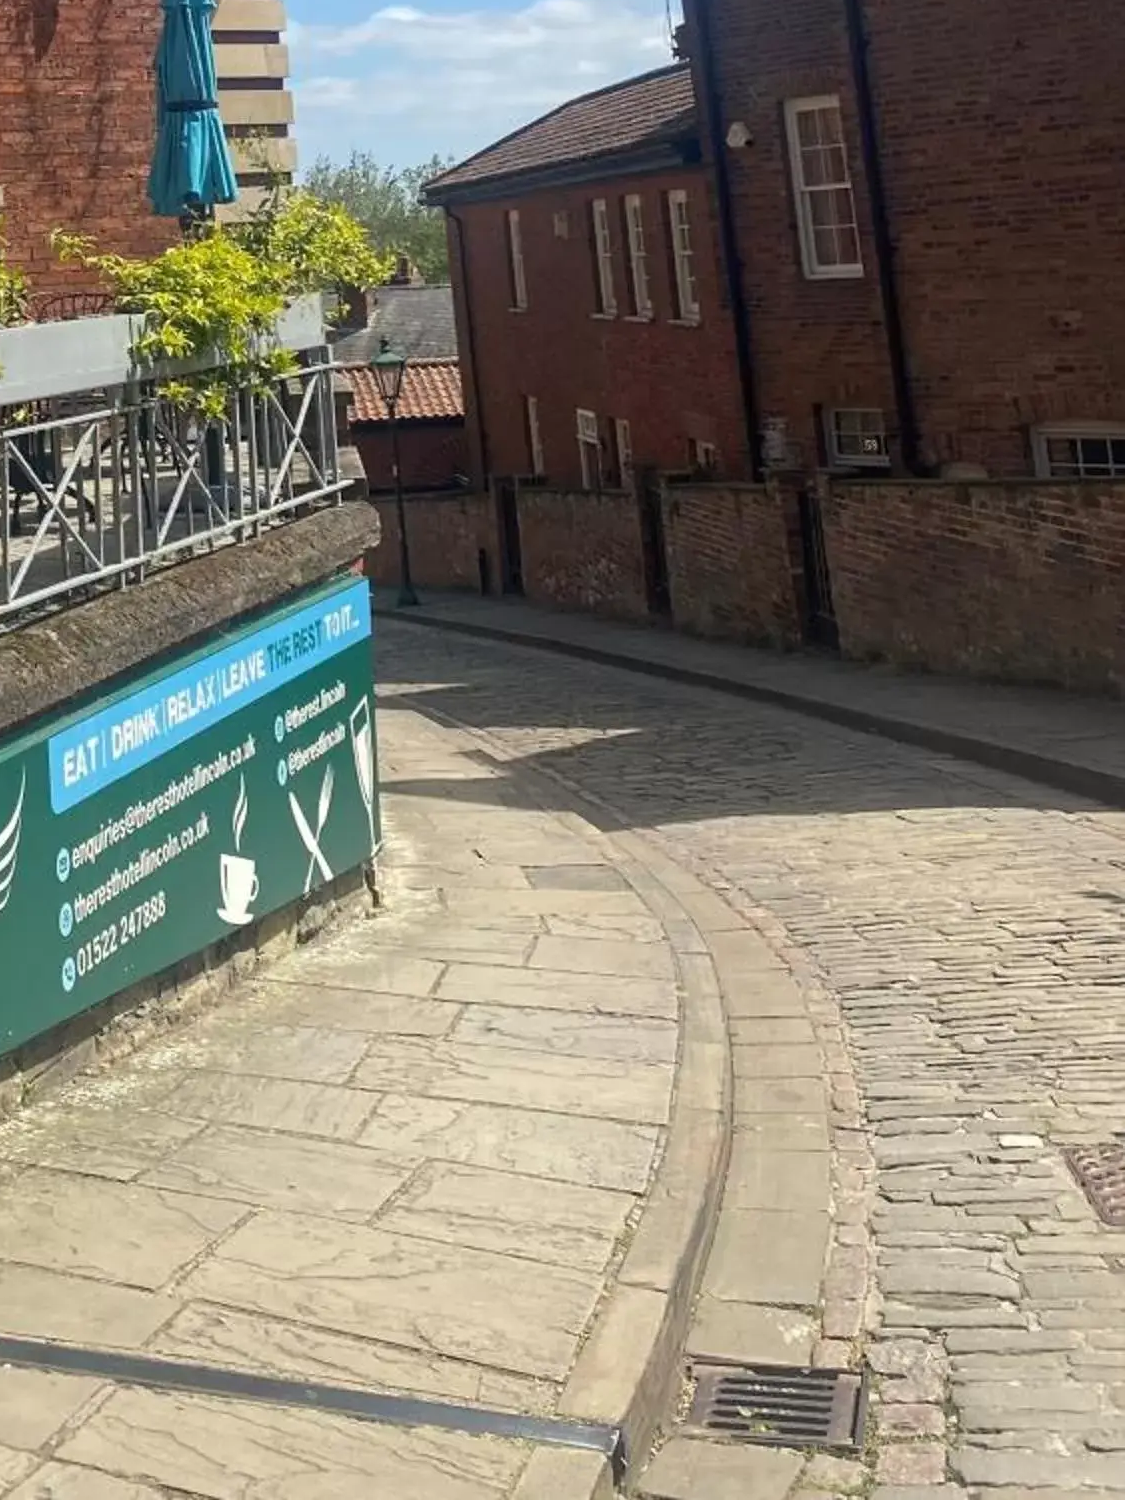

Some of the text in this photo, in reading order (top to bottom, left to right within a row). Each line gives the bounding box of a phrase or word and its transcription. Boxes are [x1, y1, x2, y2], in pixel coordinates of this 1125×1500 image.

[62, 736, 100, 787] EAT
[111, 708, 161, 760] DRINK
[166, 676, 217, 726] RELAX
[221, 651, 266, 698] LEAVE
[267, 639, 292, 673] THE
[292, 618, 322, 658] REST
[76, 924, 118, 977] 01522
